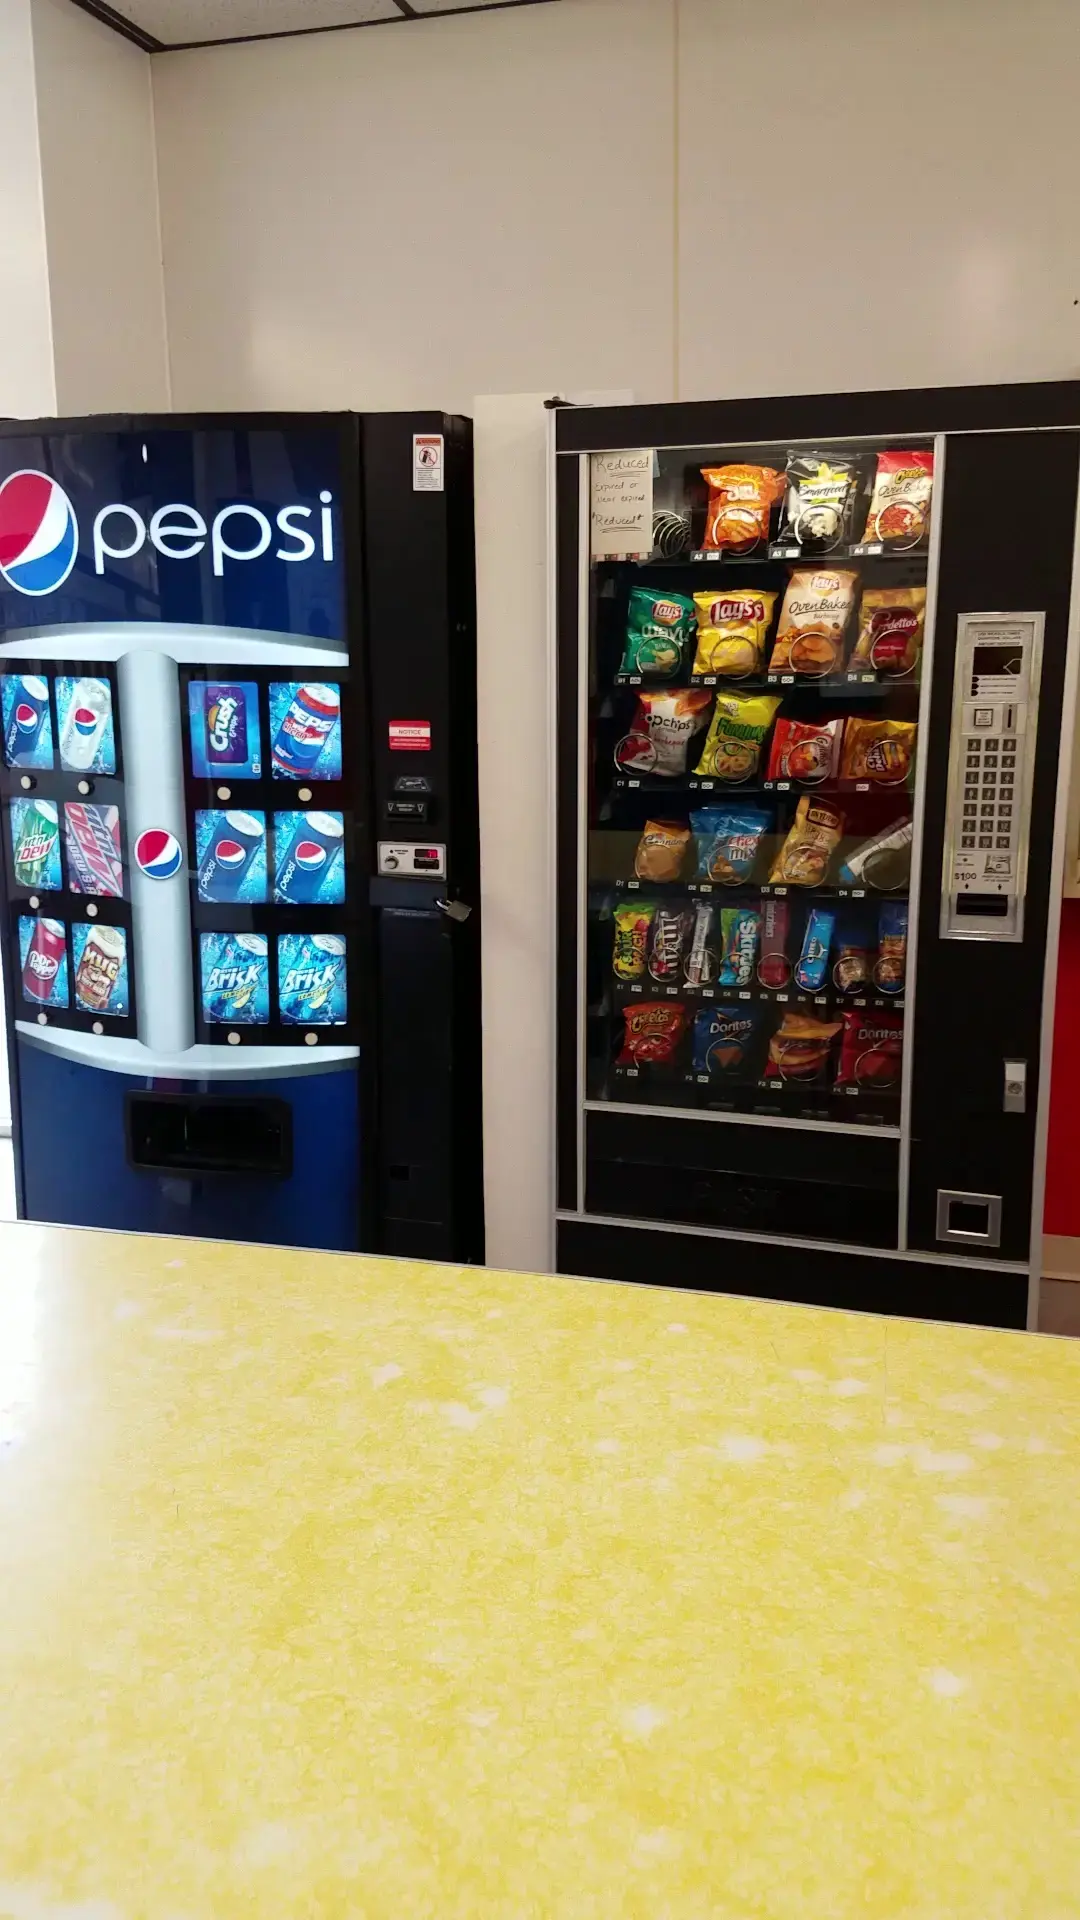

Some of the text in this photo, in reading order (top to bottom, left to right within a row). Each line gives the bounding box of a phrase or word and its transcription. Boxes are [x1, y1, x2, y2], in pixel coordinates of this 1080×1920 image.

[596, 456, 649, 472] Reduced
[620, 494, 646, 504] expired
[93, 490, 334, 576] pepsi
[655, 603, 681, 619] Lay's
[789, 602, 818, 614] Oven
[209, 697, 238, 751] Crush
[201, 858, 217, 889] pepsi
[280, 860, 297, 892] pepsi
[83, 946, 119, 981] MUG
[710, 1018, 752, 1034] Doritos
[858, 1028, 904, 1040] Doritos
